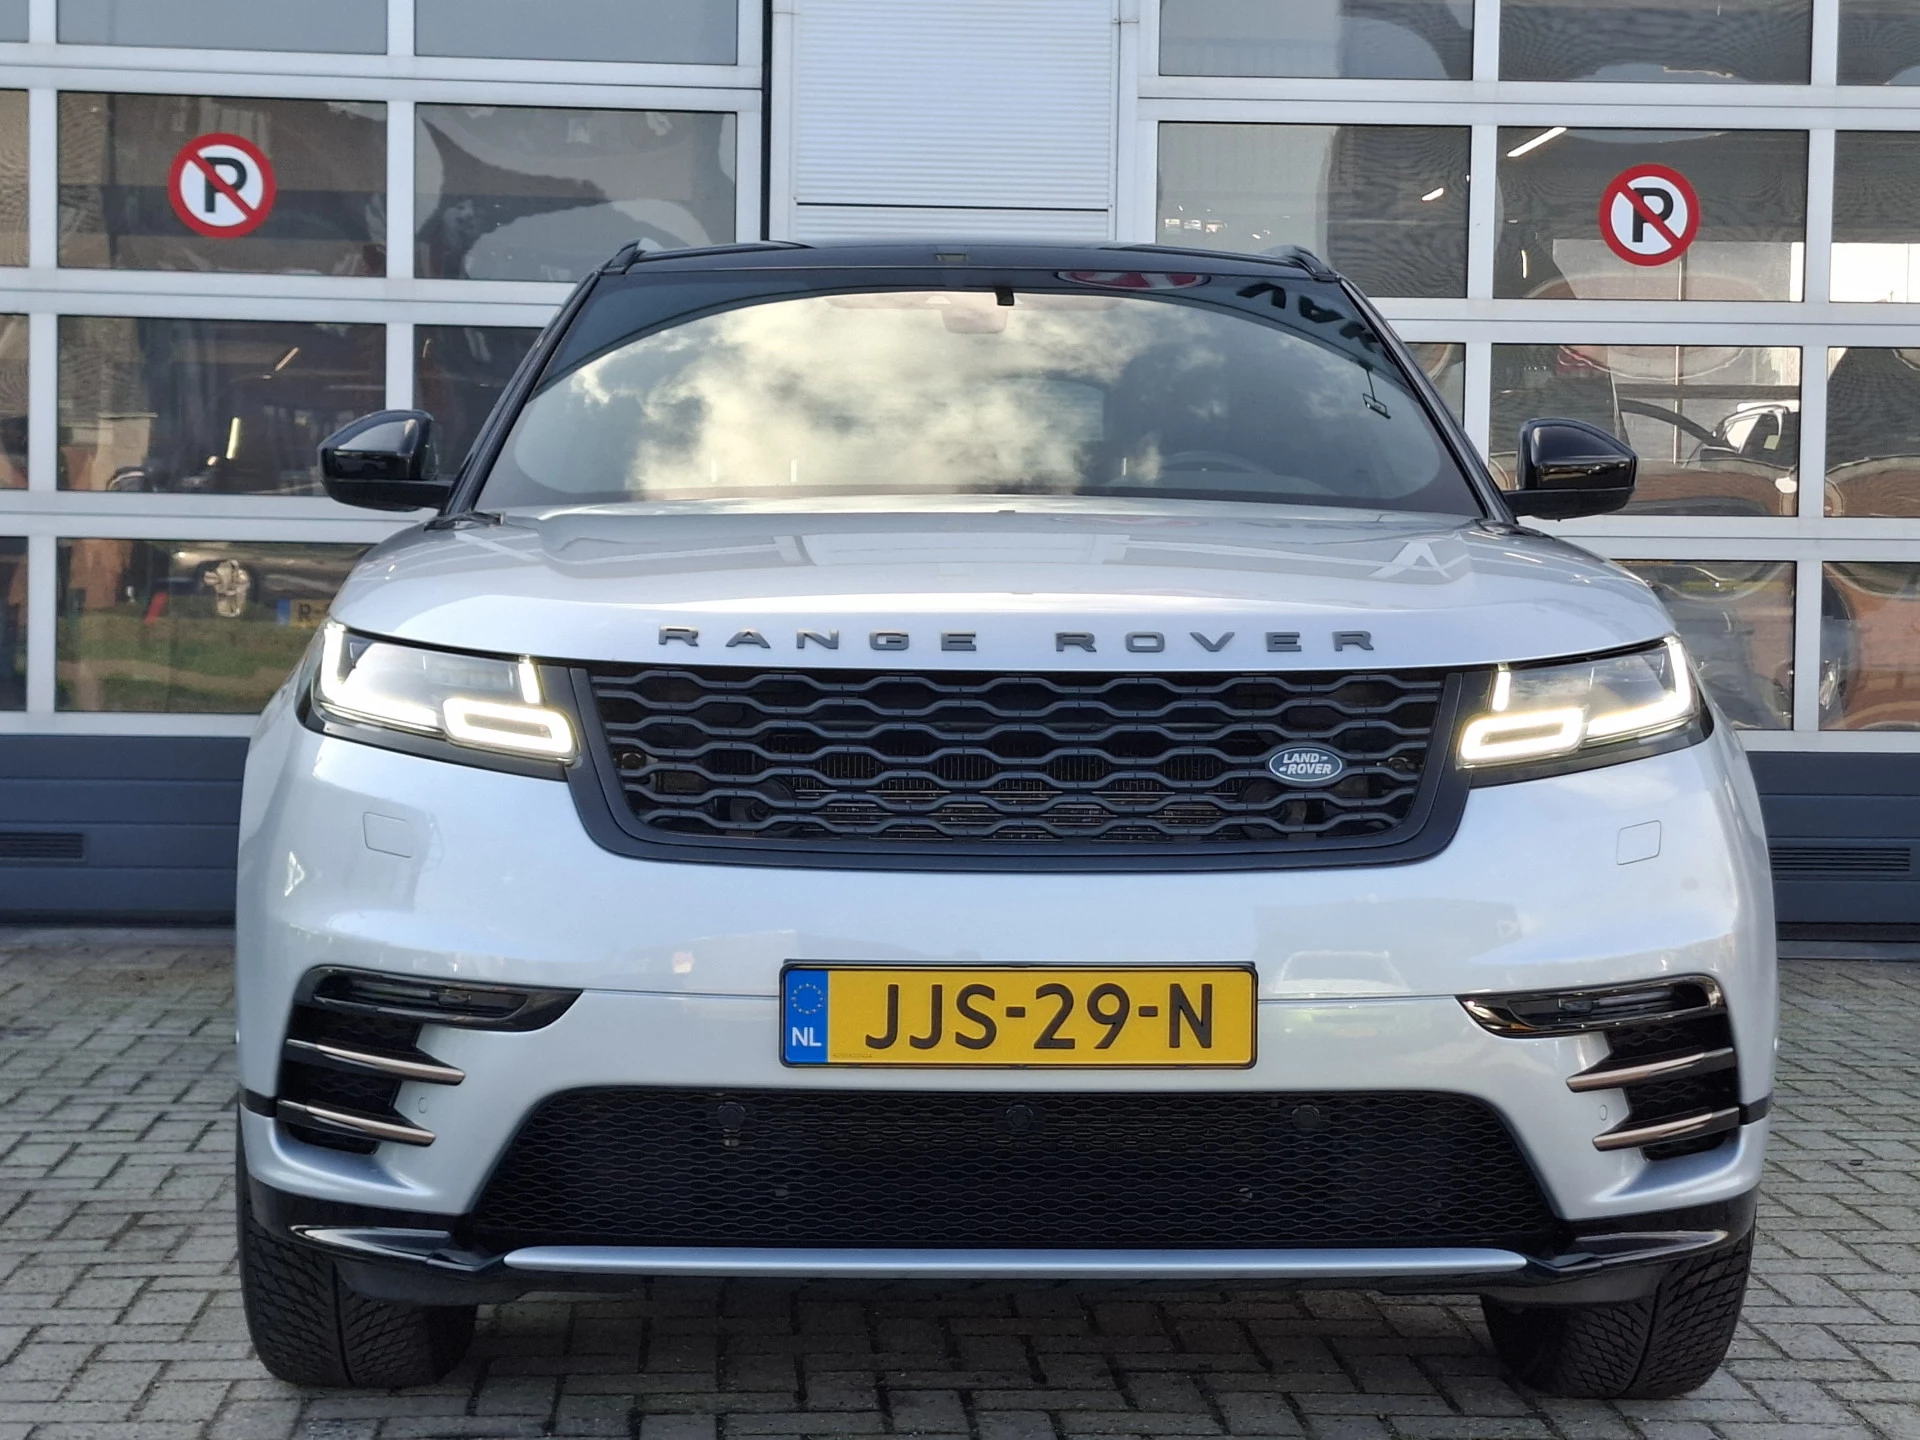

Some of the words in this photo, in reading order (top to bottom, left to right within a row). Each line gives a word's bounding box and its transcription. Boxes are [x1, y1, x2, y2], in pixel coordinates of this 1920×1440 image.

[204, 156, 247, 213] P
[1632, 187, 1674, 243] P
[657, 624, 977, 652] RANGE
[1055, 630, 1375, 653] ROVER
[791, 1026, 822, 1047] NL
[864, 982, 1213, 1050] JJS-29-N
